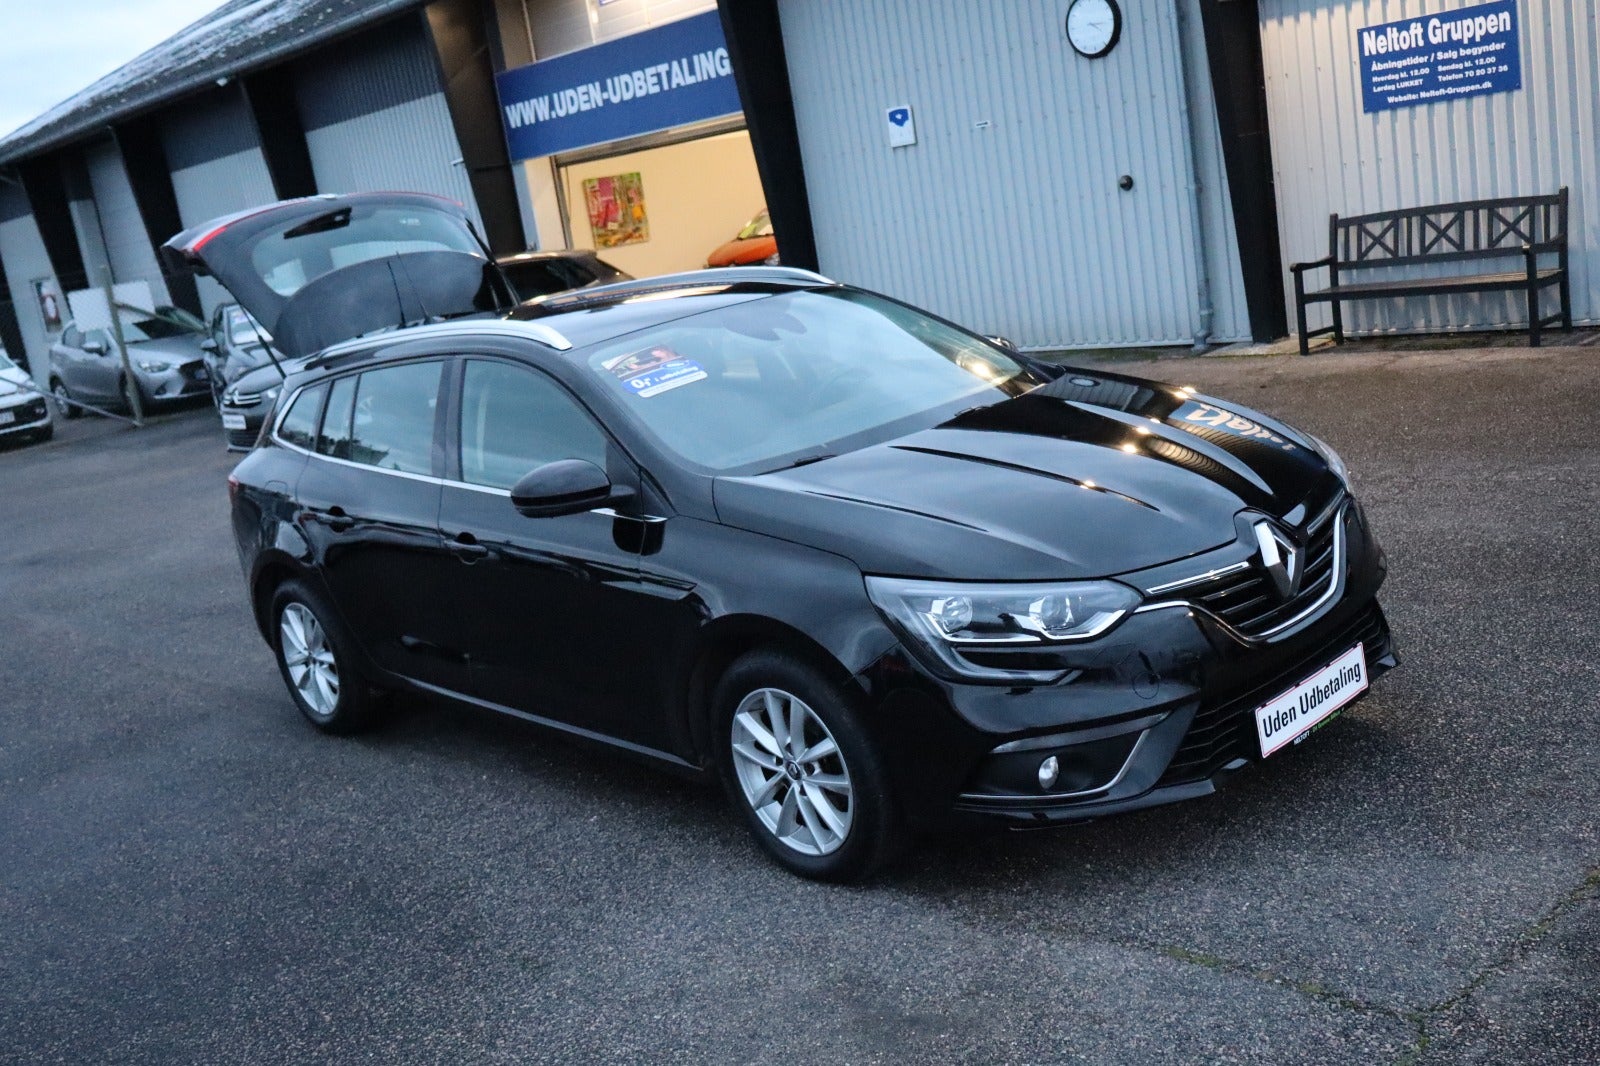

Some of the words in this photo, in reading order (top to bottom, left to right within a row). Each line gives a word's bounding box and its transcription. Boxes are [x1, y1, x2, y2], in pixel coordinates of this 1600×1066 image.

[1363, 22, 1424, 56] Neltoft
[1428, 10, 1511, 45] Gruppen
[1371, 55, 1429, 72] Åbningstider
[1436, 49, 1458, 61] Salg
[1459, 41, 1506, 57] begynder
[1387, 93, 1419, 104] Website:
[1262, 706, 1297, 738] Uden
[1299, 662, 1362, 715] Udbetaling
